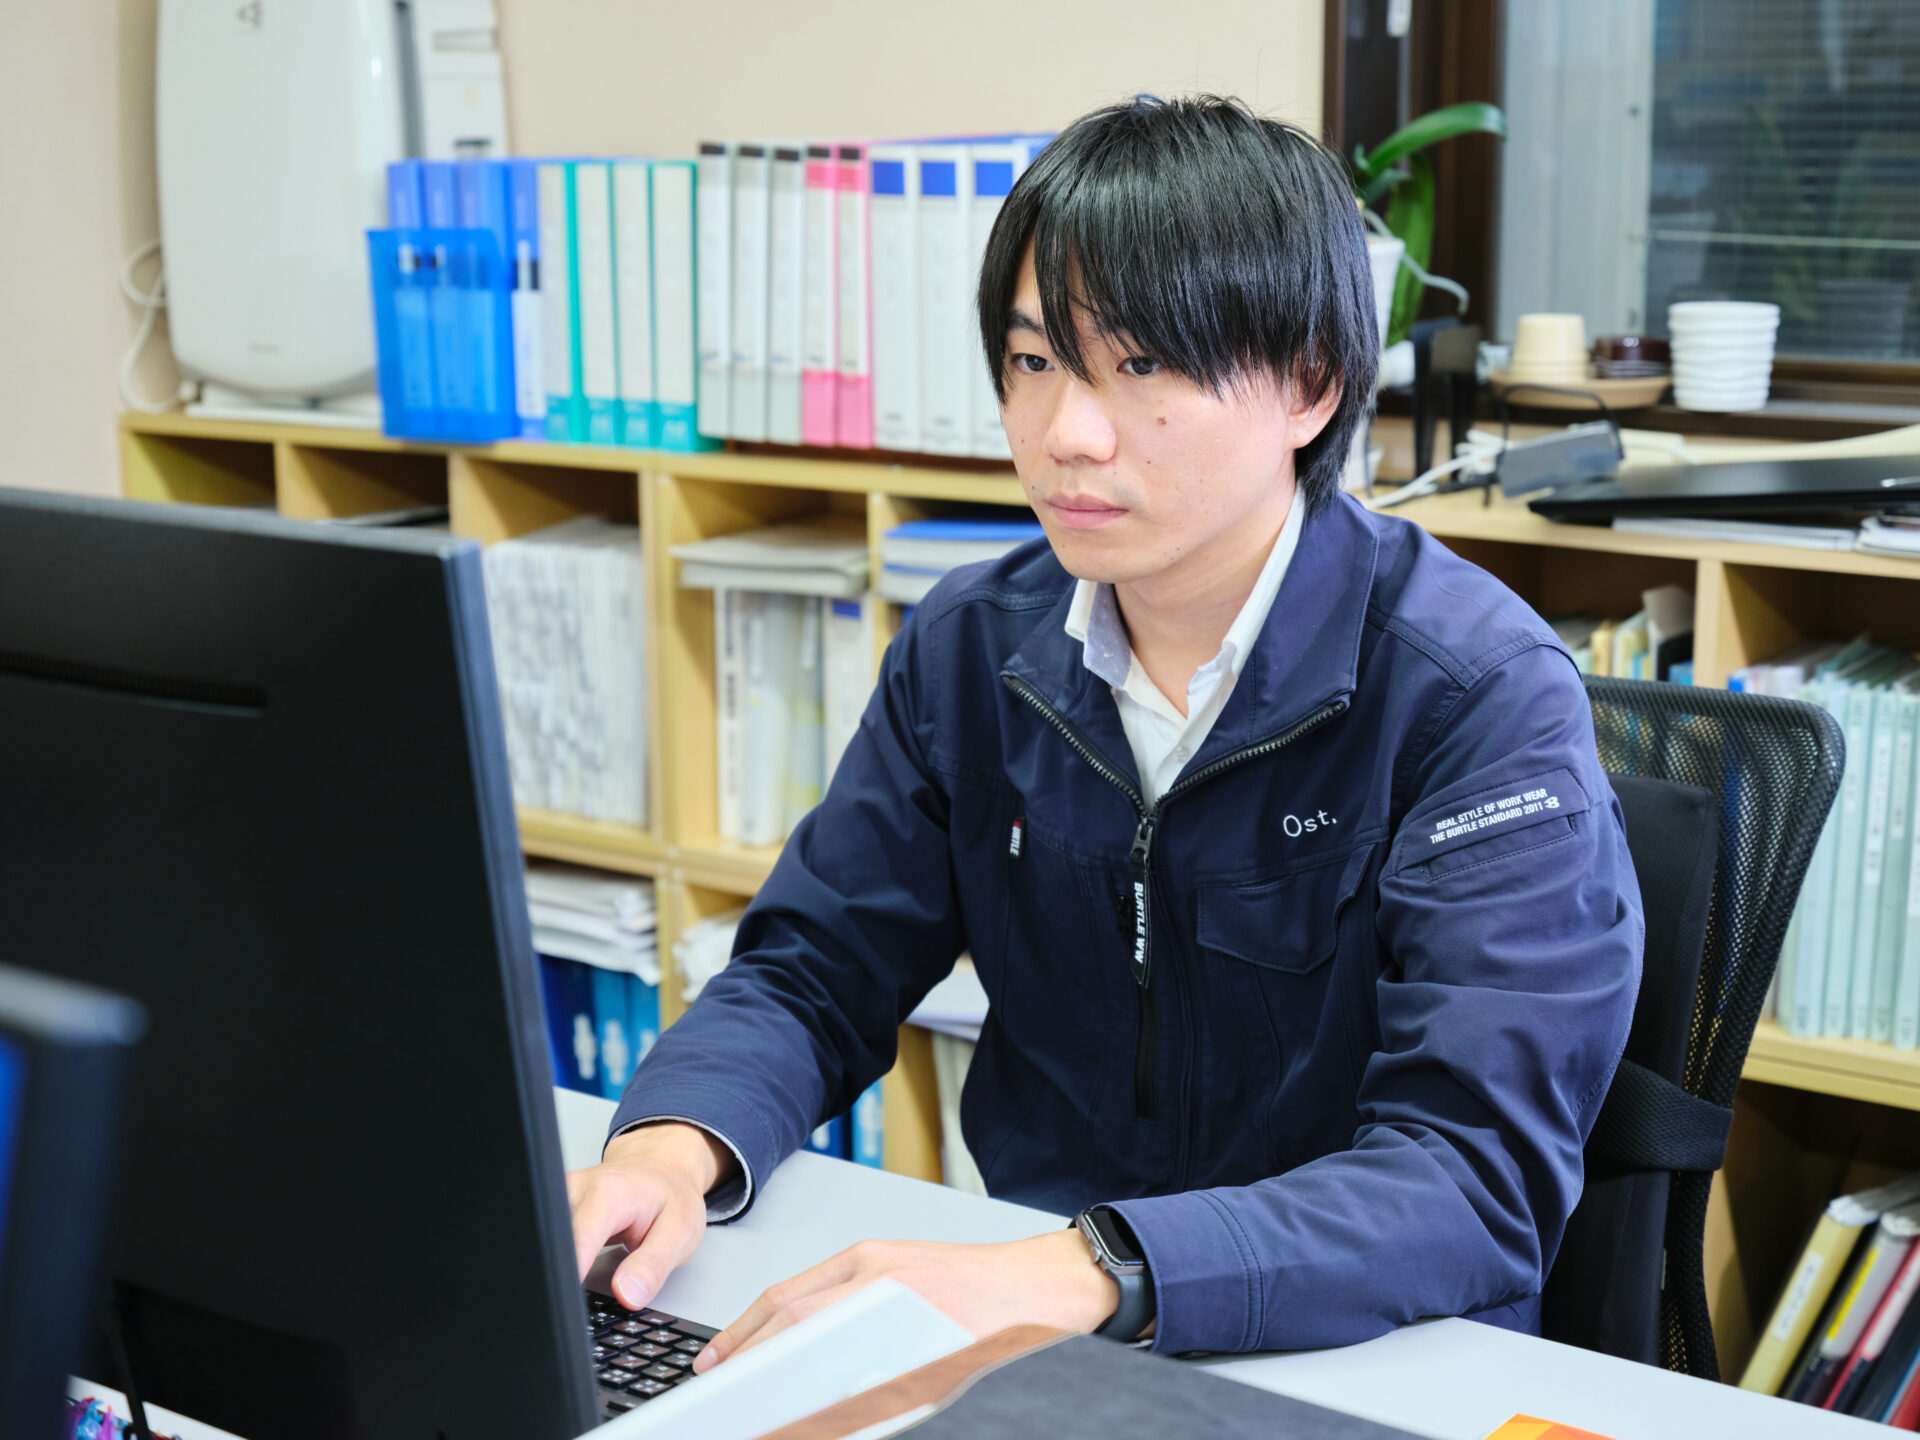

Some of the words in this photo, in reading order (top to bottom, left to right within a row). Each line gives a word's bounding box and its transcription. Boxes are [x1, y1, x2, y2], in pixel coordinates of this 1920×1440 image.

[1282, 809, 1338, 838] Ost.
[1429, 831, 1447, 845] THE
[1446, 820, 1478, 840] BURTLE
[1478, 806, 1523, 829] STANDARD
[1523, 801, 1544, 816] 2011
[1436, 817, 1457, 831] REAL
[1458, 806, 1484, 824] STYLE
[1484, 802, 1497, 814] OF
[1496, 795, 1524, 811] WORK
[1522, 787, 1548, 803] WEAR
[1133, 881, 1146, 937] BURTLE
[1134, 936, 1146, 965] WW
